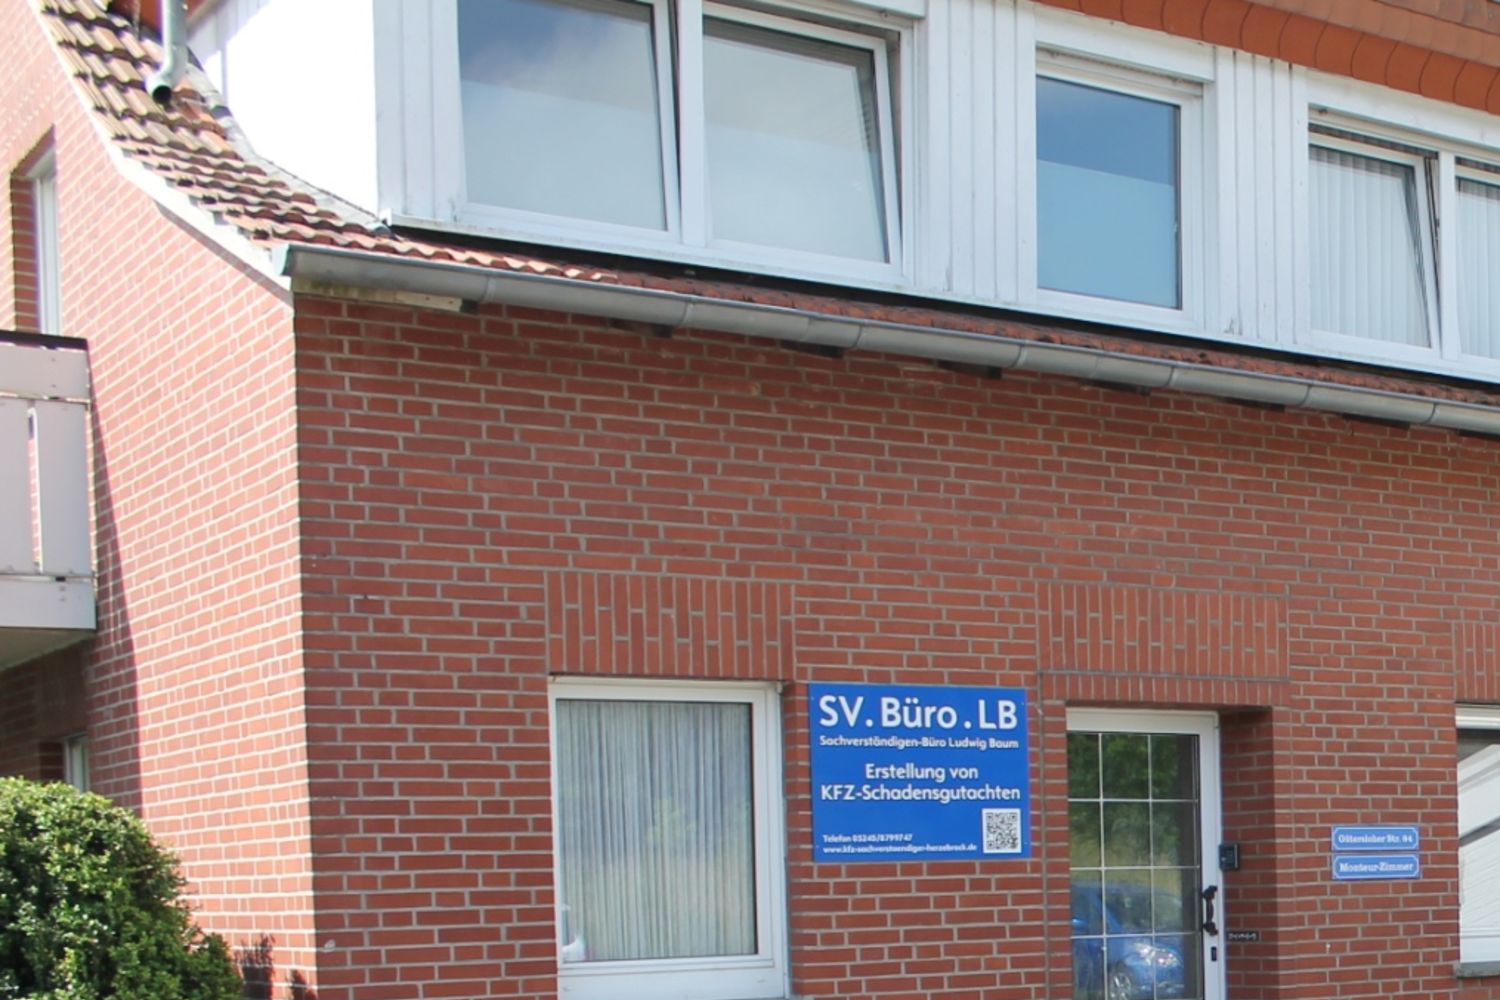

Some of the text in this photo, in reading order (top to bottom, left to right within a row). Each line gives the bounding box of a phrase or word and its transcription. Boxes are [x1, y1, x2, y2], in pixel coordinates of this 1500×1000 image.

[819, 735, 1019, 751] Sachverständigen-Büro Ludwig Baum
[865, 762, 979, 783] Erstellung von
[821, 784, 1021, 804] KFZ-Schadensgutachten
[822, 834, 851, 844] Telefon
